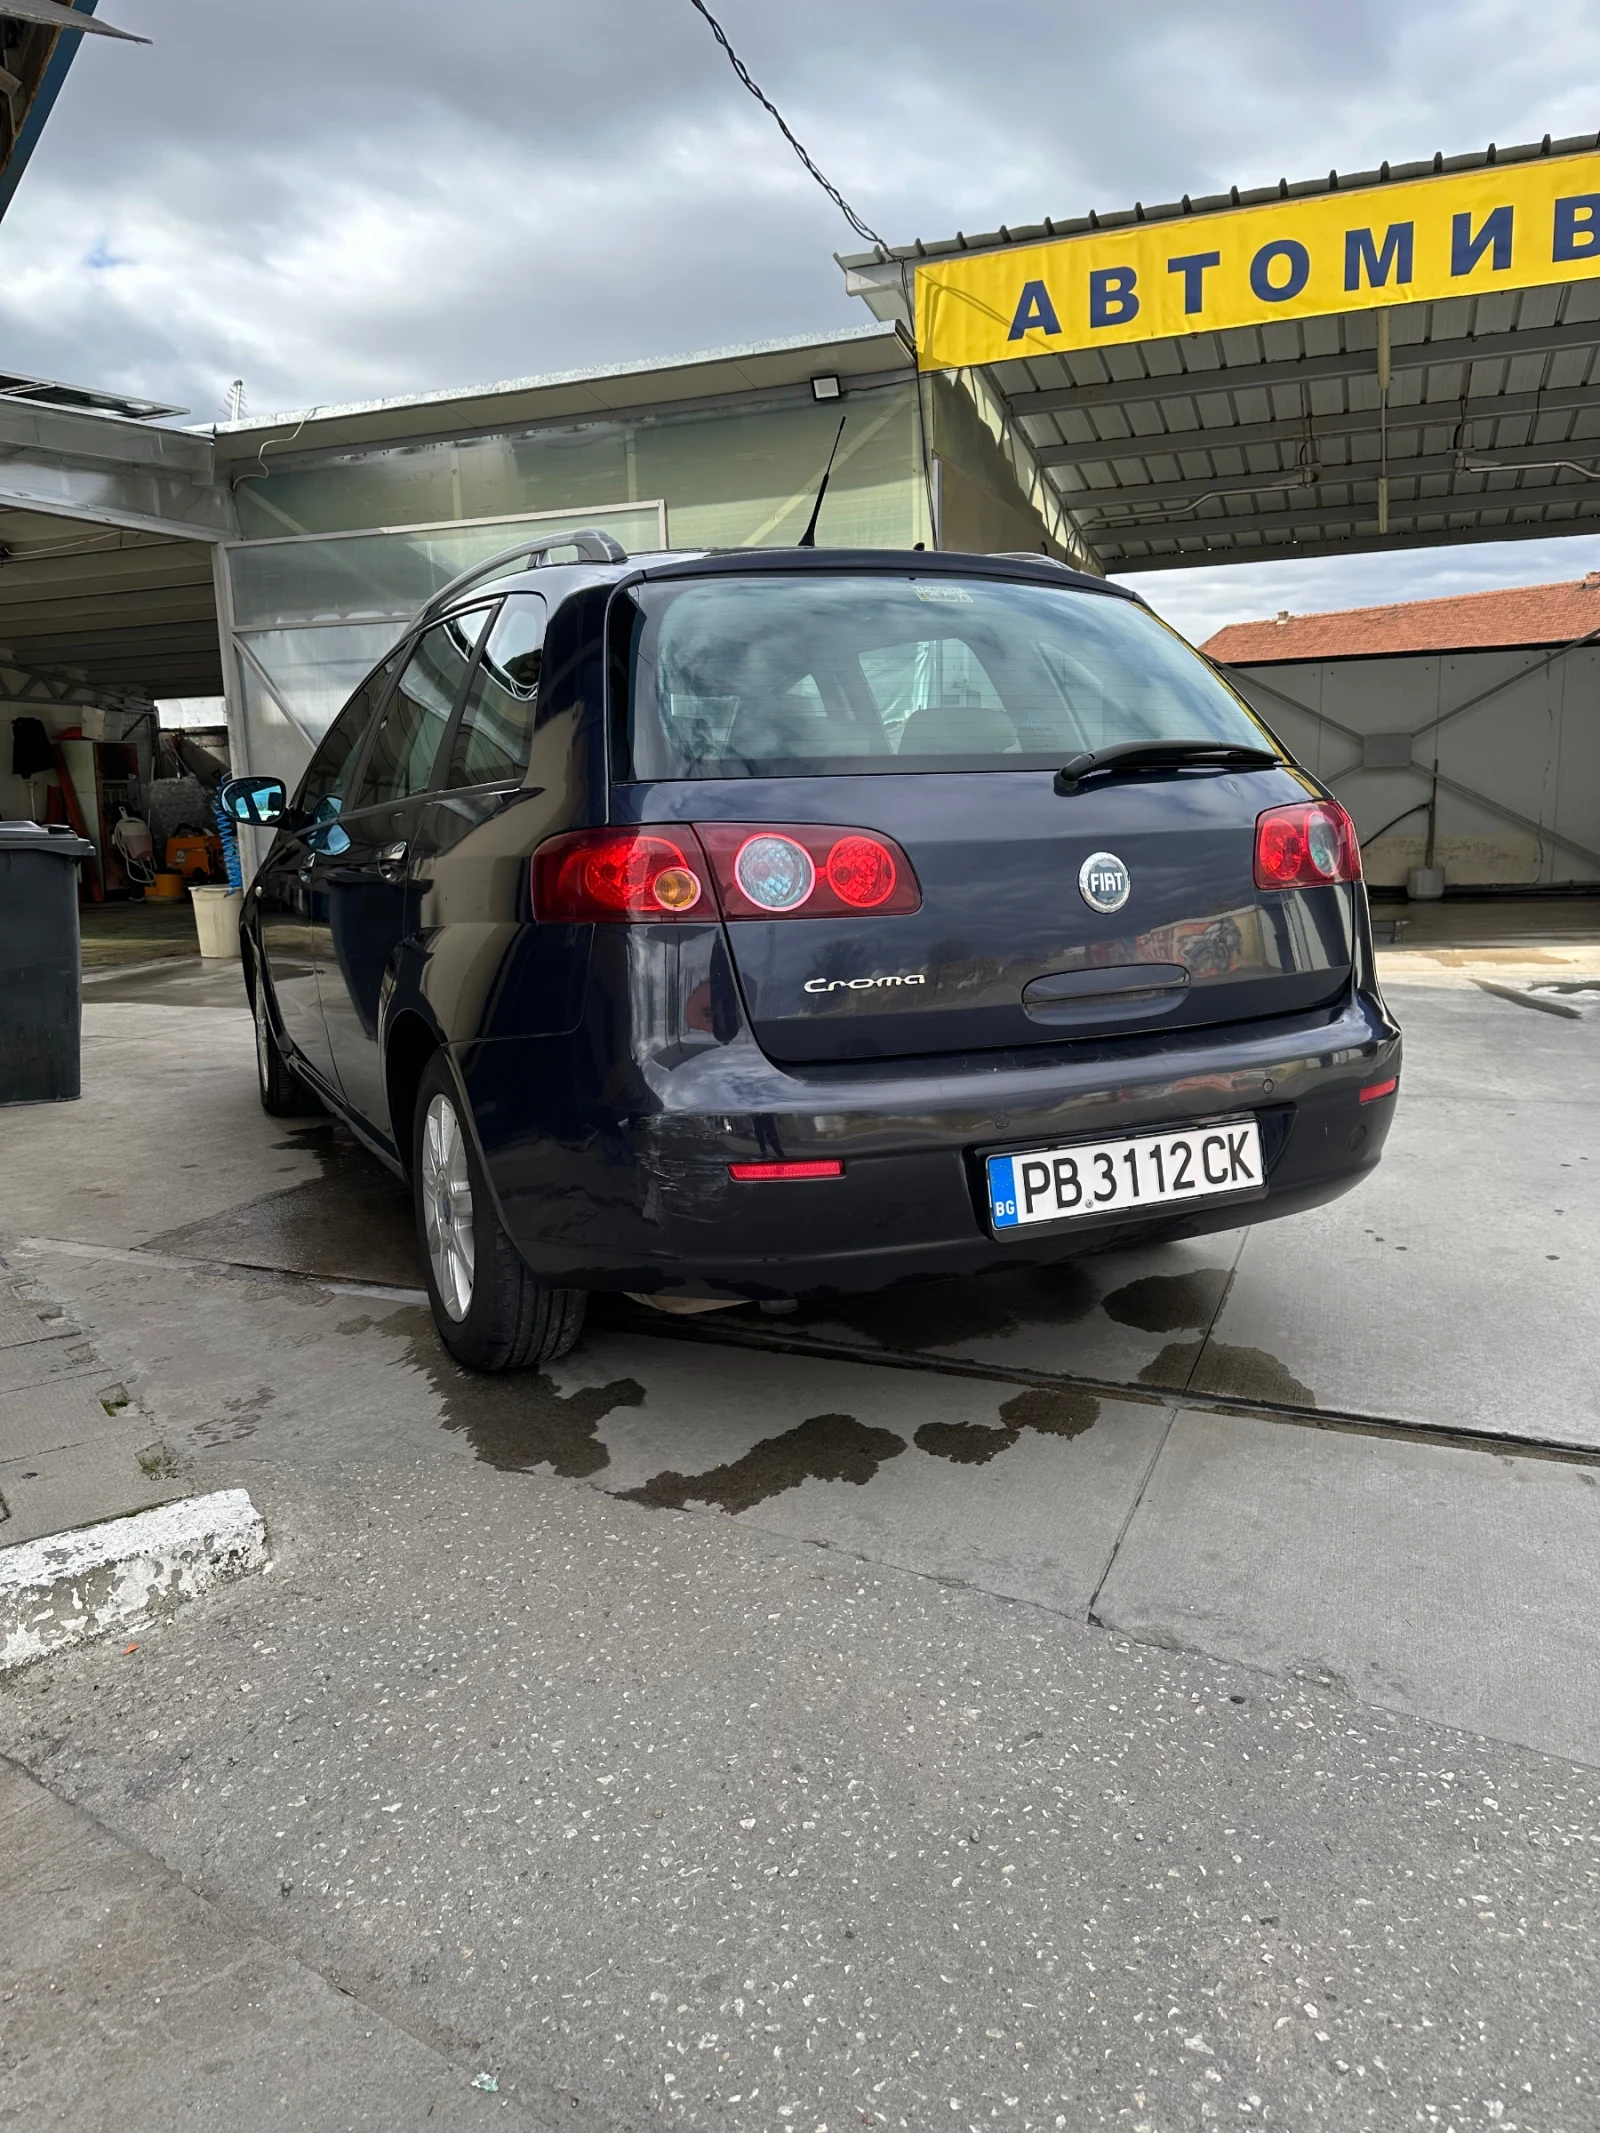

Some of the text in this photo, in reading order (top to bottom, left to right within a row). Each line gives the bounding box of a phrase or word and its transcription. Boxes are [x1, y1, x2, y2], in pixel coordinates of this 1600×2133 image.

[1007, 192, 1600, 341] АВТОМИВ
[1090, 872, 1123, 892] FIAT
[804, 974, 926, 993] Croma
[995, 1199, 1015, 1217] BG
